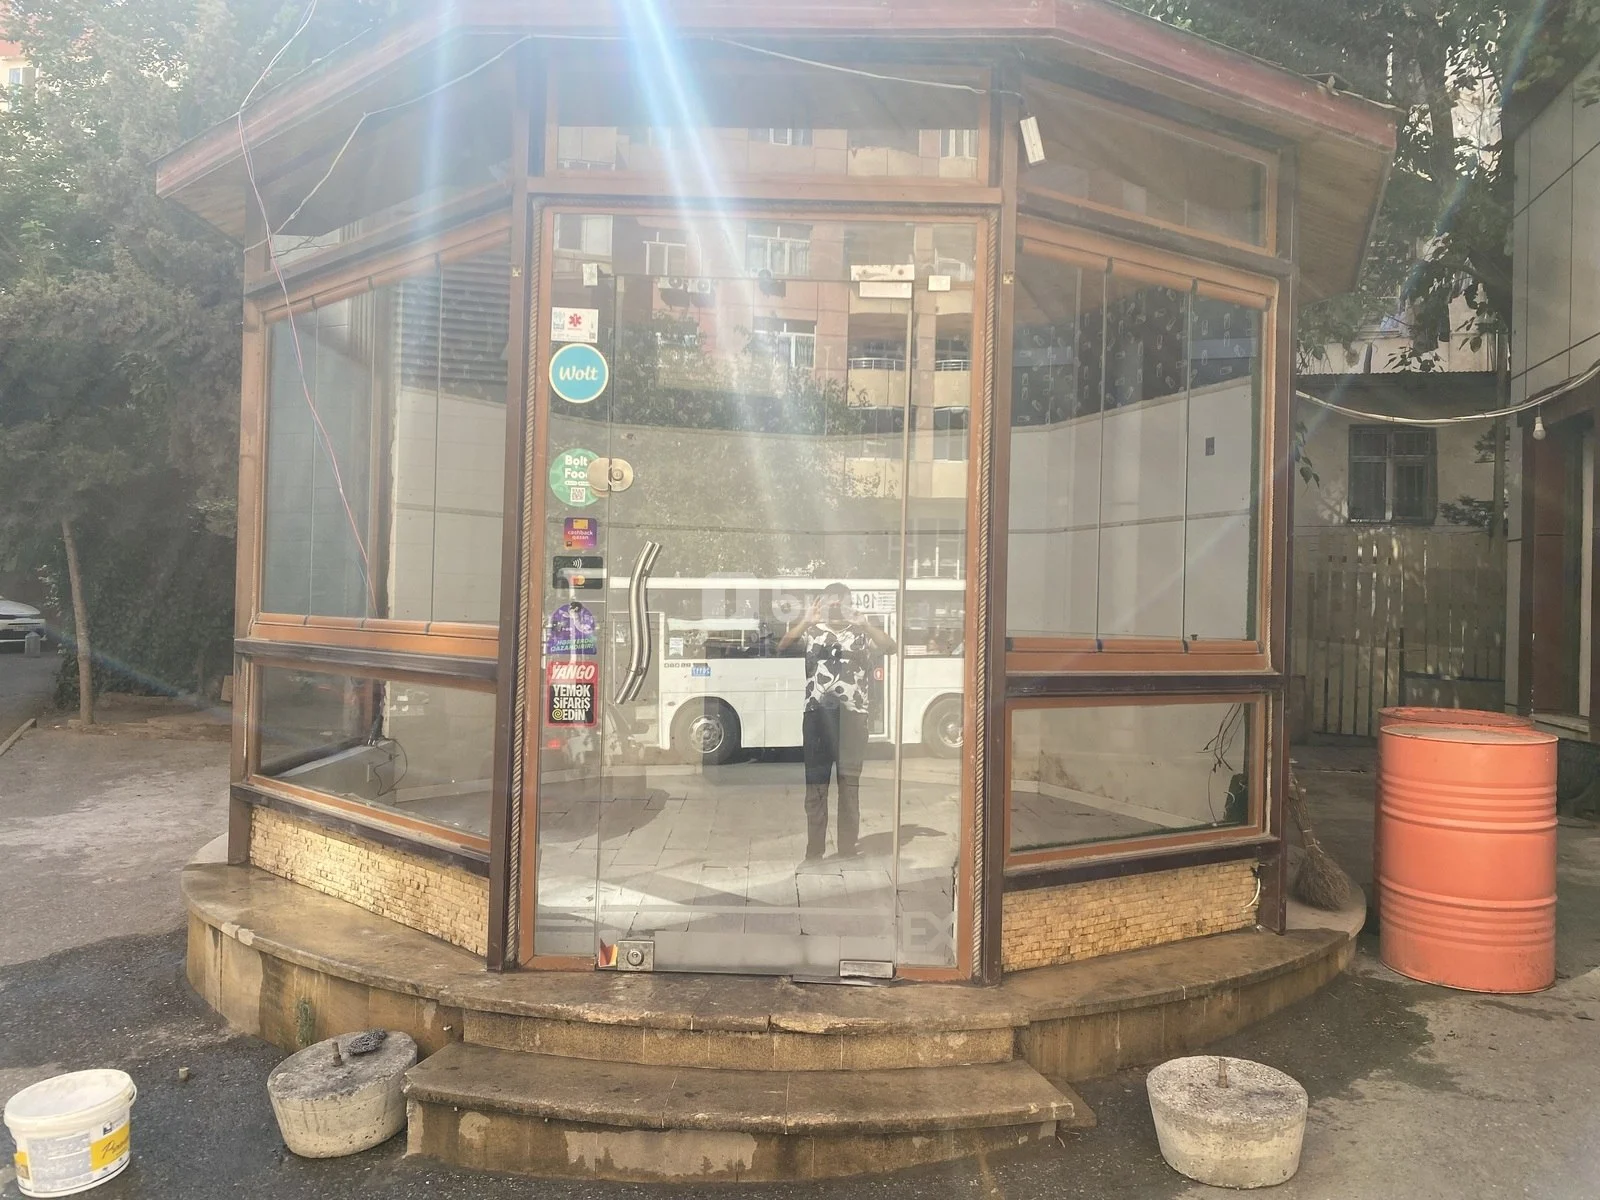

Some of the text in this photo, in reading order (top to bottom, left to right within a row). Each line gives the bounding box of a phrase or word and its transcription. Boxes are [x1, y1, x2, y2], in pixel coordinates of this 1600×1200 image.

[559, 365, 599, 382] Wolt
[565, 455, 588, 466] Bolt
[564, 468, 588, 479] Foo
[551, 664, 595, 680] YANGO
[552, 684, 591, 697] YEMƏK
